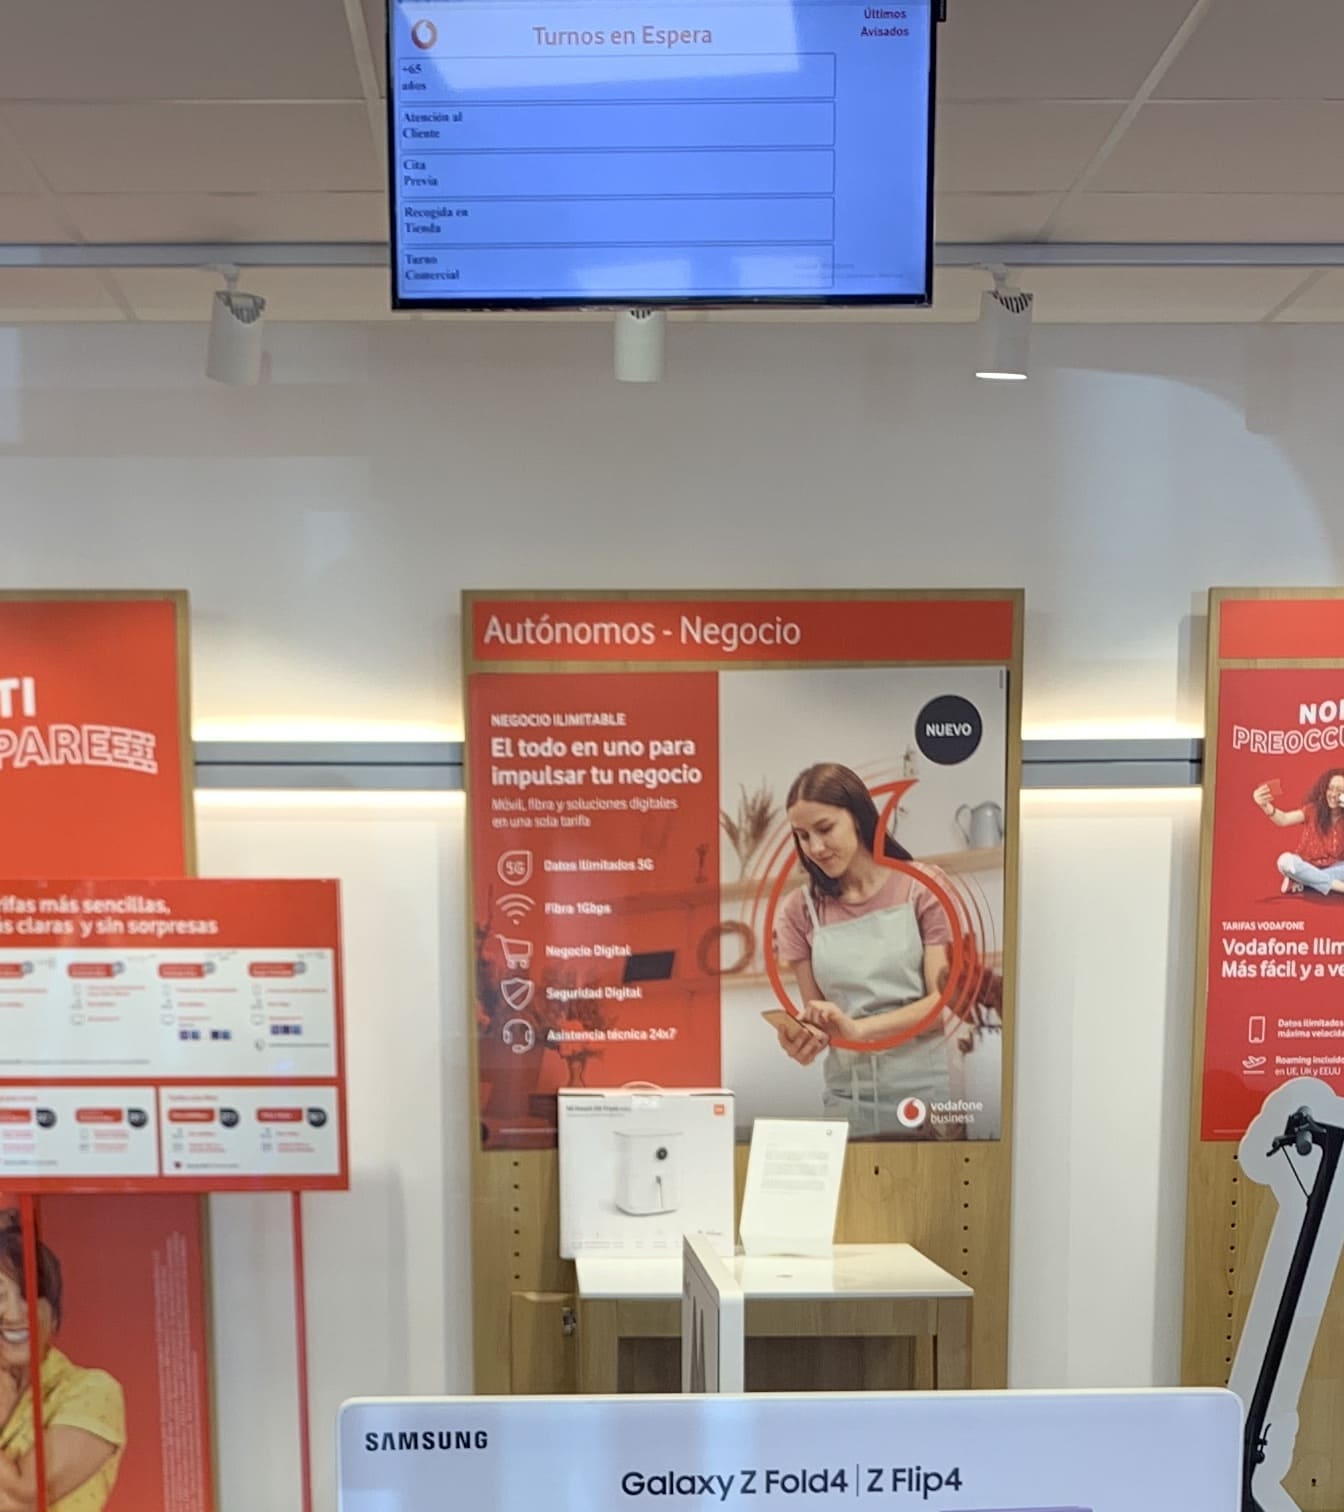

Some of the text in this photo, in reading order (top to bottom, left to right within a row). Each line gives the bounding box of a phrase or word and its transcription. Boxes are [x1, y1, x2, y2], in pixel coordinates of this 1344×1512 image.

[863, 6, 907, 19] Últimos
[532, 25, 712, 47] Turnos en Espera
[860, 25, 909, 37] Avisados
[403, 111, 463, 122] Atención al
[402, 127, 440, 138] Cliente
[403, 158, 426, 170] Cita
[403, 175, 438, 186] Previa
[404, 206, 468, 219] Recogida en
[404, 222, 441, 232] Tienda
[404, 254, 437, 264] Turno
[405, 268, 459, 280] Comercial
[482, 614, 802, 652] Autónomos Negocio
[490, 711, 627, 726] NEGOCIO ILIMITABLE
[925, 720, 972, 737] NUEVO
[490, 736, 696, 760] El todo en uno para
[490, 763, 703, 789] impulsar tu negocio
[491, 796, 679, 812] Móvil, fibra y soluciones digitales
[491, 814, 591, 828] en una sola tarifa
[506, 860, 525, 876] 5G
[544, 859, 576, 871] Datos
[636, 859, 654, 871] 5G
[39, 895, 78, 914] más
[81, 894, 170, 916] sencillas,
[545, 902, 611, 917] Fibra 1Gbps
[16, 917, 73, 935] claras
[79, 920, 92, 938] y
[96, 917, 124, 934] sin
[127, 917, 219, 937] sorpresas
[1221, 920, 1305, 931] TARIFAS VODAFONE
[545, 944, 631, 959] Negocio Digital
[1221, 937, 1308, 955] Vodafone
[1221, 959, 1256, 978] Más
[1260, 959, 1297, 977] fácil
[1299, 964, 1311, 980] y
[1313, 964, 1324, 977] a
[546, 985, 642, 1001] Seguridad Digital
[1277, 1018, 1301, 1028] Datos
[546, 1027, 677, 1041] Asistencia técnica 24x7
[1277, 1028, 1310, 1038] máxima
[1275, 1055, 1311, 1066] Roaming
[1274, 1068, 1284, 1077] en
[1318, 1066, 1341, 1076] EEUU
[930, 1099, 983, 1112] vodafone
[930, 1112, 975, 1124] business
[364, 1430, 489, 1451] SAMSUNG
[621, 1466, 962, 1500] Galaxy Z Fold4 Z Flip4
